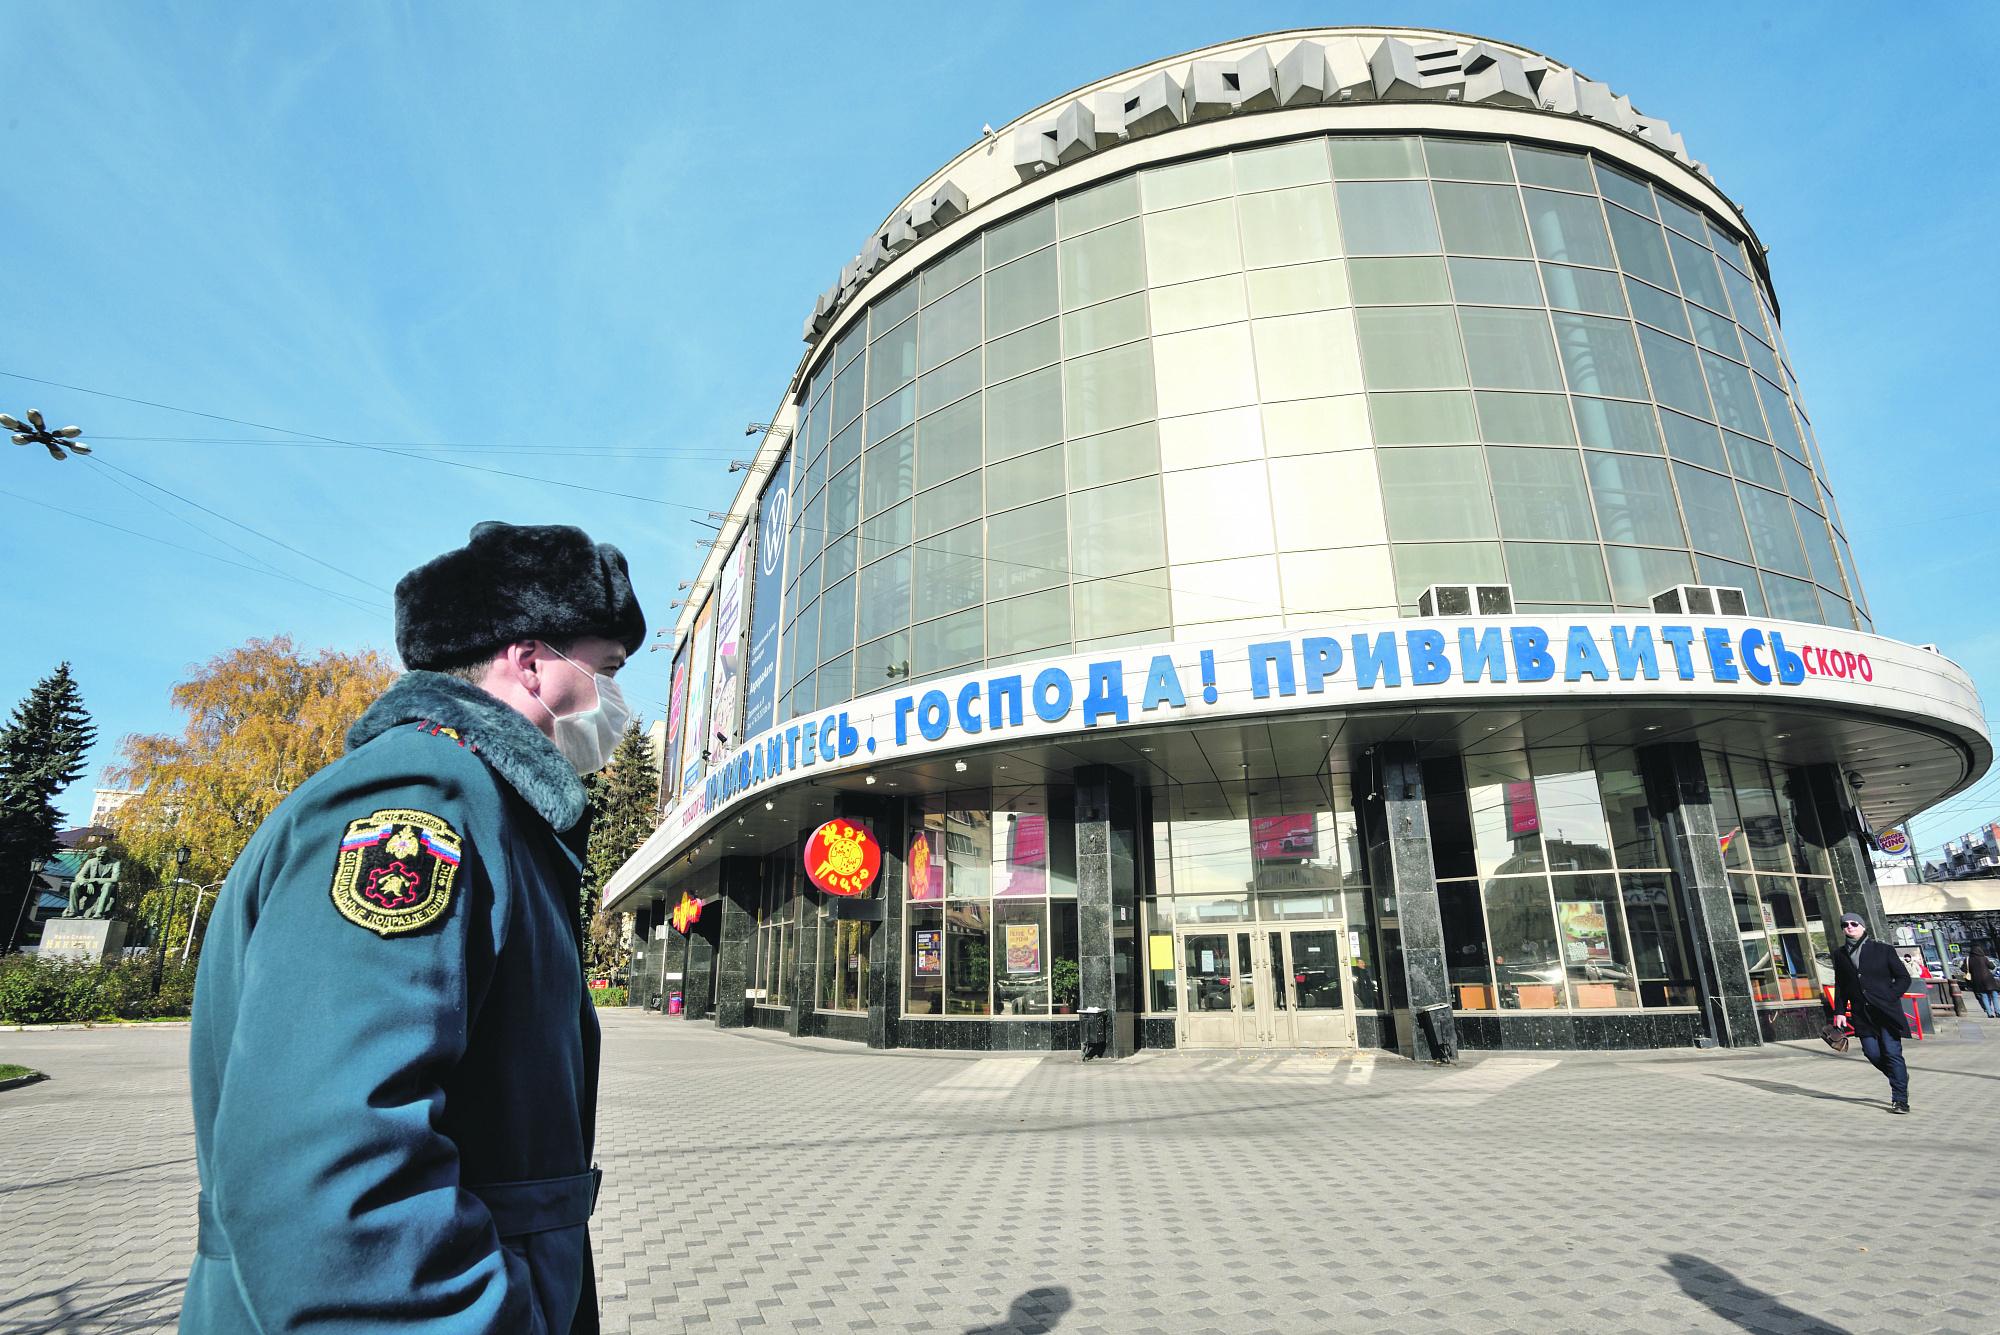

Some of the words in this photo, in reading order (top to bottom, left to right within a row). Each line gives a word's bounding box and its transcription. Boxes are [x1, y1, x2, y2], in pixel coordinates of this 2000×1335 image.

[1802, 645, 1873, 683] СКОРО
[895, 649, 1218, 746] ГОСПОДА!
[401, 814, 442, 831] РОССИИ
[1880, 832, 1903, 843] BURGER
[1881, 836, 1905, 849] KING
